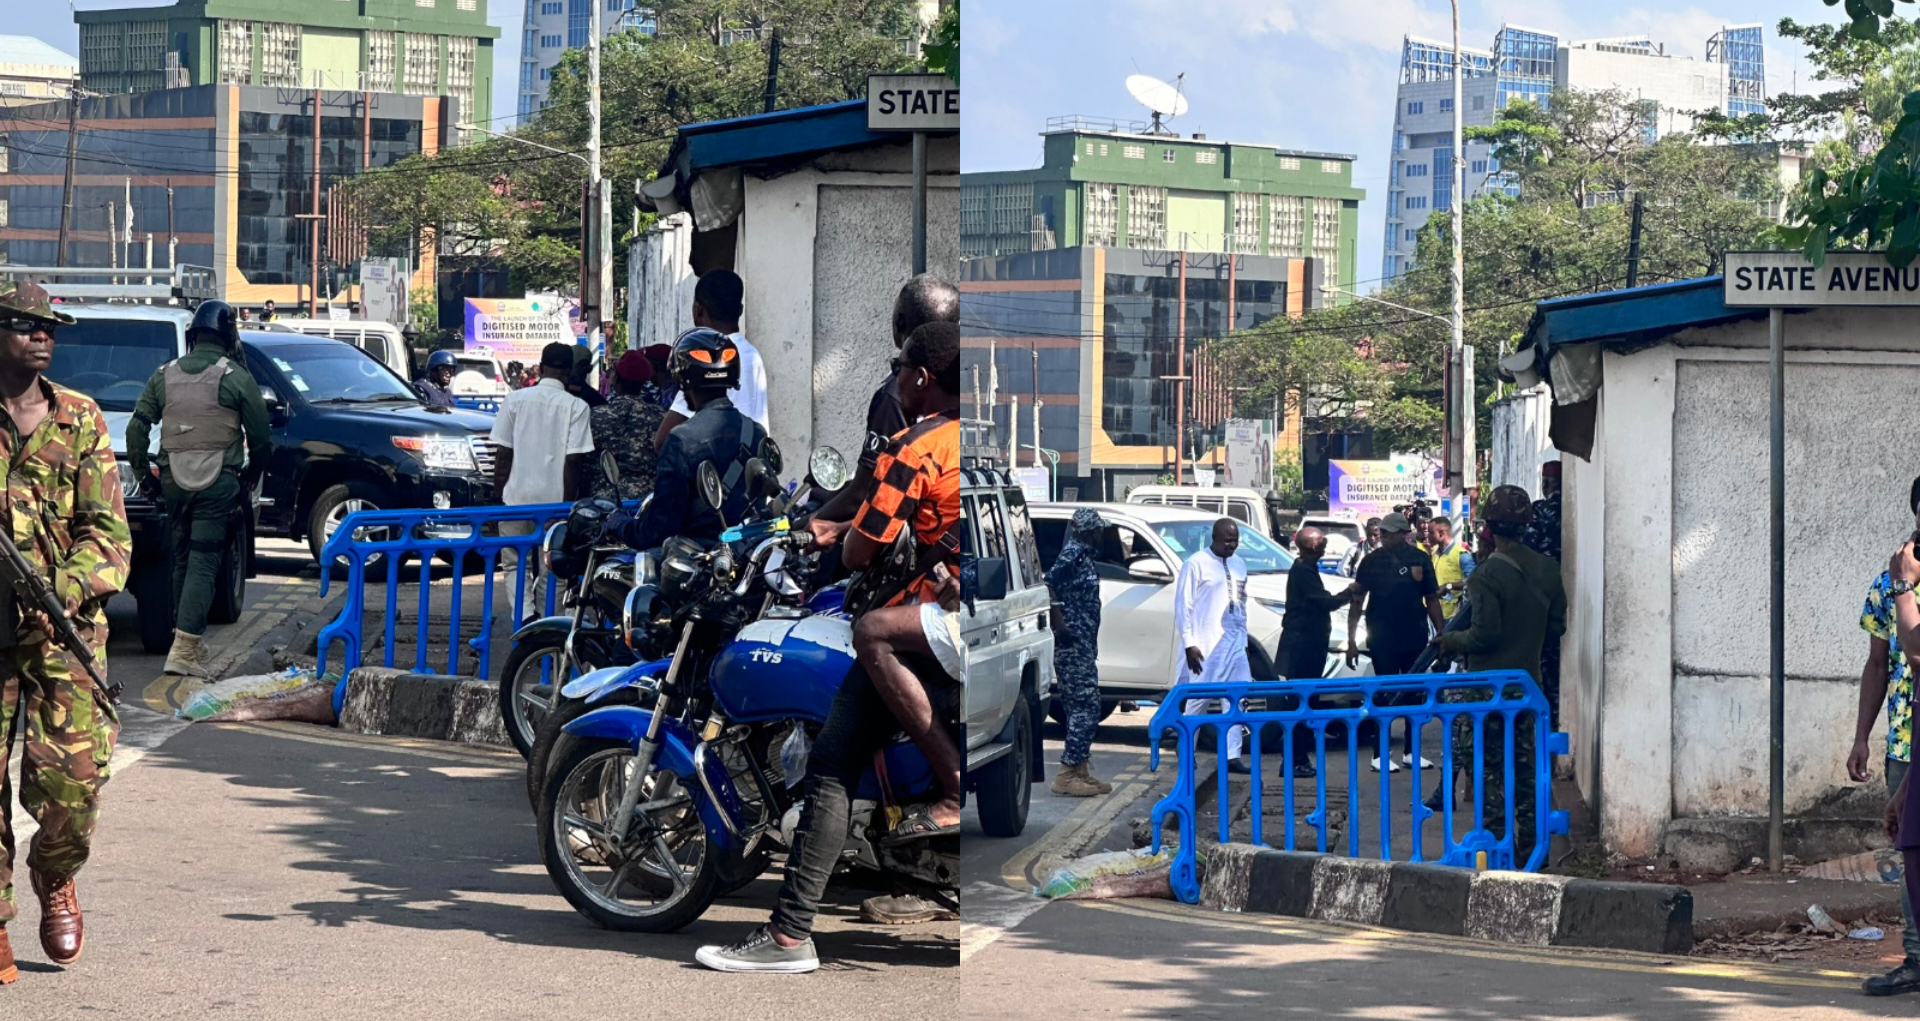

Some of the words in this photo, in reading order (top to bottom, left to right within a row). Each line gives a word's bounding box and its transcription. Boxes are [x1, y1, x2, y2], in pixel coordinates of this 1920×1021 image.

[878, 89, 960, 115] STATE
[1735, 266, 1815, 291] STATE
[482, 322, 526, 331] DIGITISED
[528, 322, 560, 331] MOTOR
[482, 332, 524, 340] INSURANCE
[526, 332, 561, 340] DATABASE
[1347, 483, 1390, 492] DIGITISED
[1347, 493, 1388, 501] INSURANCE
[1390, 493, 1414, 501] DATAB
[603, 570, 621, 580] TVS
[750, 649, 783, 664] TVS
